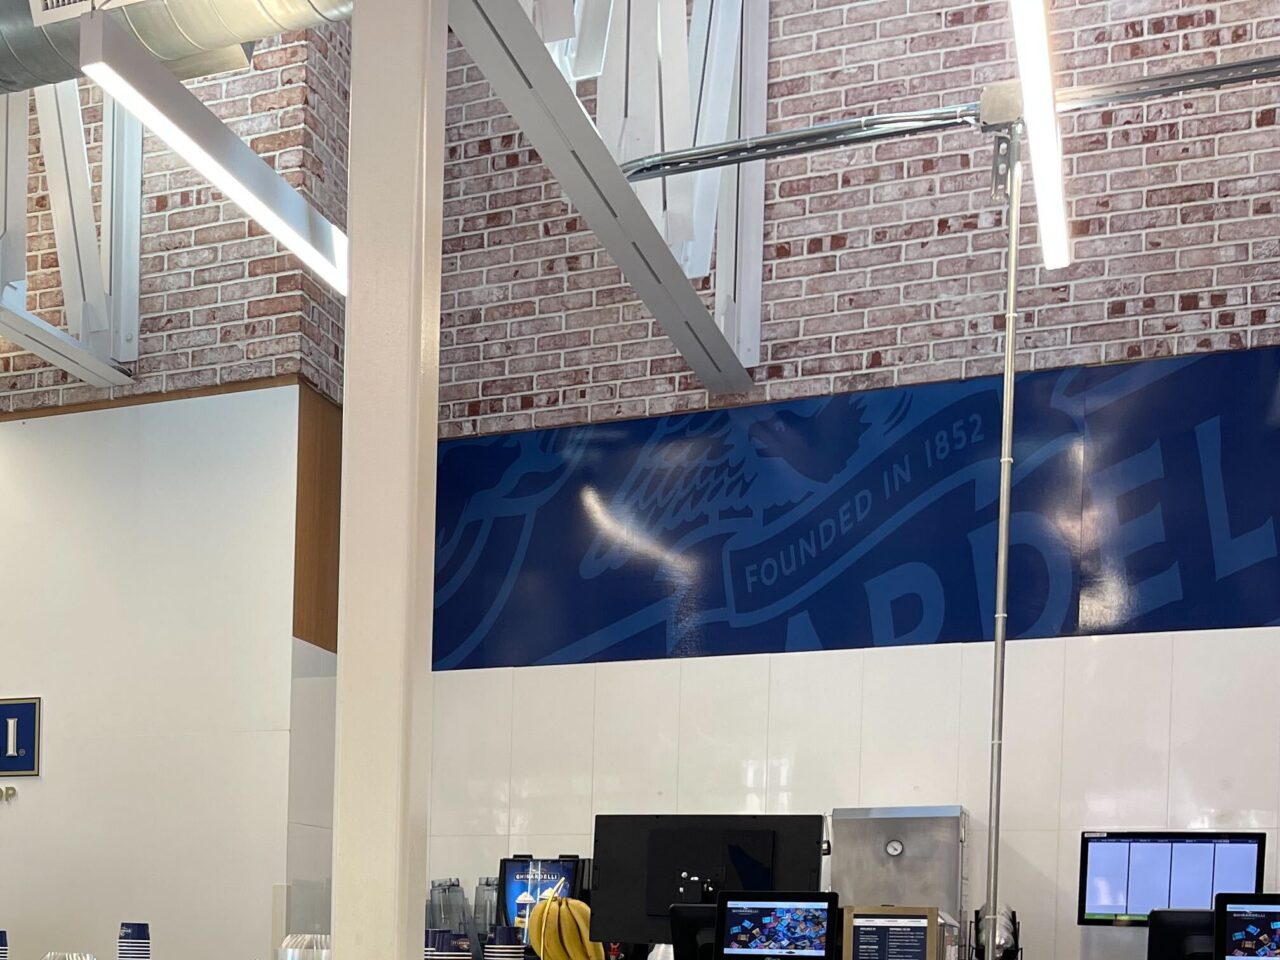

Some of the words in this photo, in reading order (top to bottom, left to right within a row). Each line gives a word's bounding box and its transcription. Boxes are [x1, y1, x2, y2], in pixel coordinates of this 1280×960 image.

[744, 488, 873, 593] FOUNDED
[882, 454, 912, 499] IN
[923, 412, 985, 468] 1852
